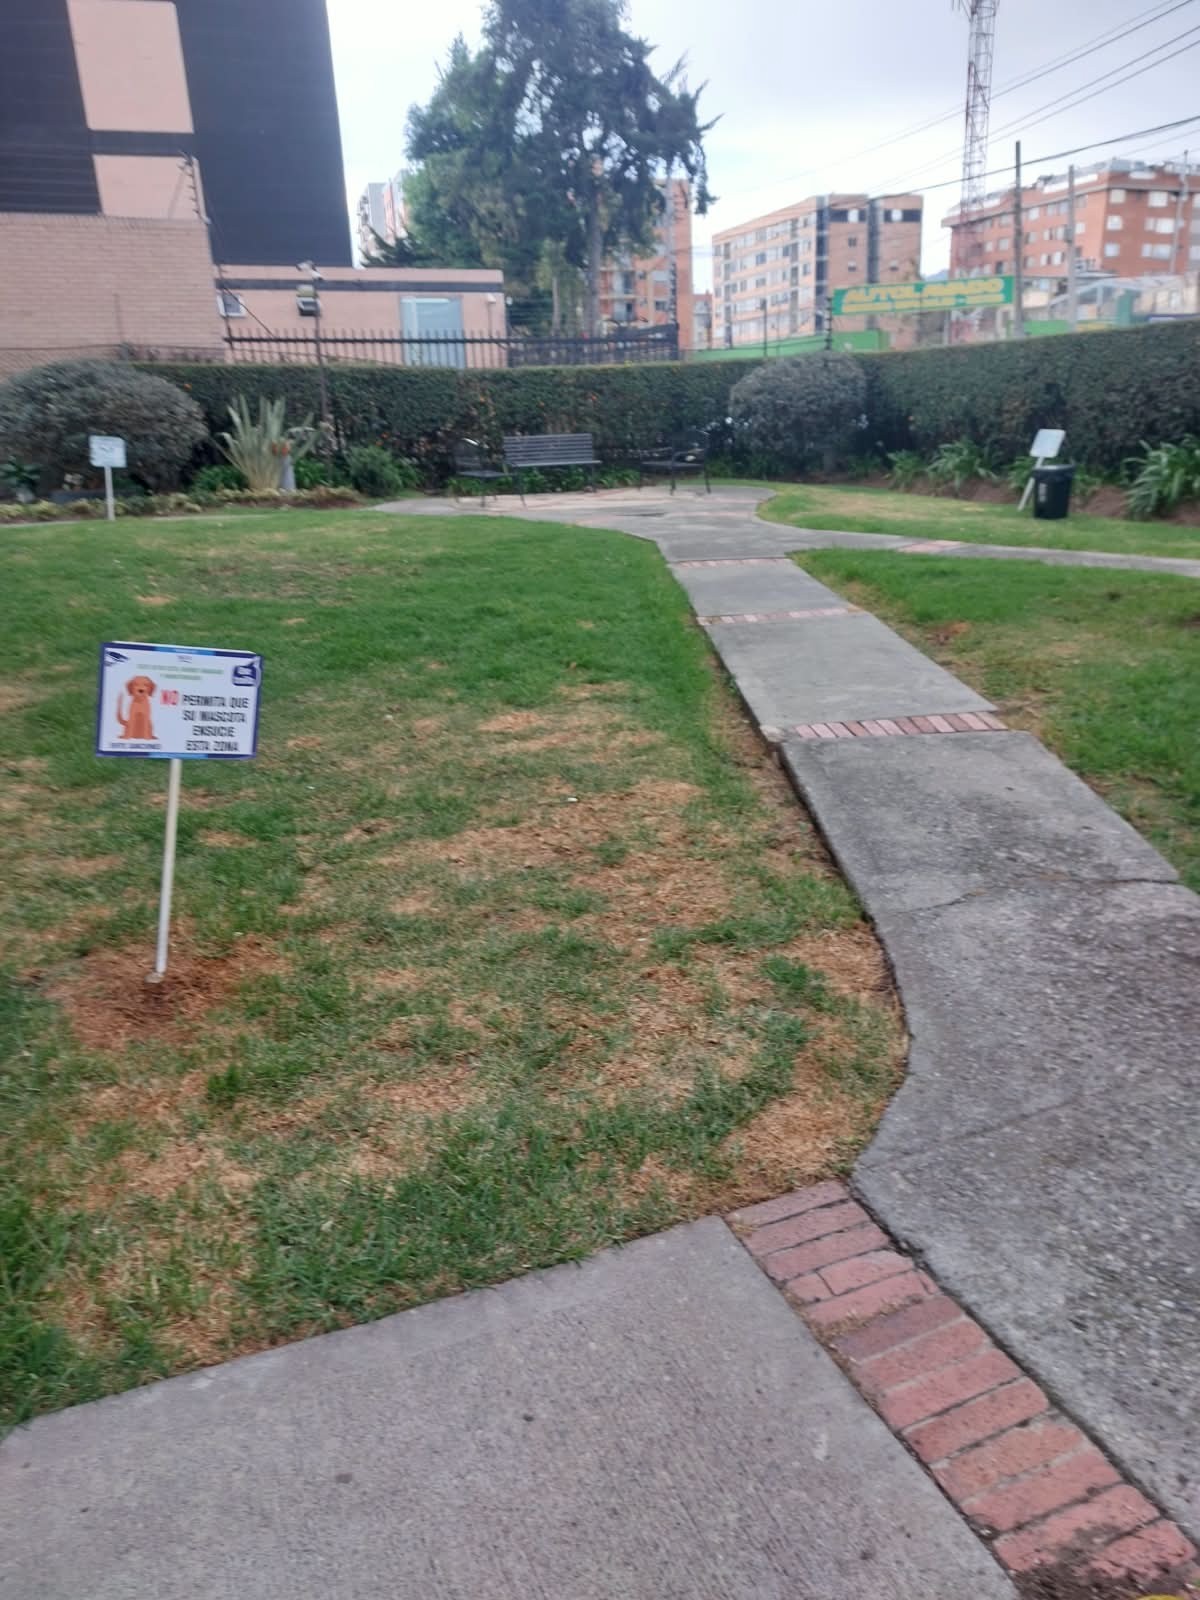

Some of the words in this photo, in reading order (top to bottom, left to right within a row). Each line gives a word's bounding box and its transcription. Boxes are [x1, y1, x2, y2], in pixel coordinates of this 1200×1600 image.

[160, 689, 179, 706] NO
[182, 694, 226, 707] PERMITA
[230, 697, 249, 709] QUE
[182, 710, 196, 721] SU
[200, 711, 246, 723] MASCOTA
[192, 725, 235, 737] ENSUCIE
[186, 740, 210, 751] ESTA
[214, 741, 239, 752] ZONA
